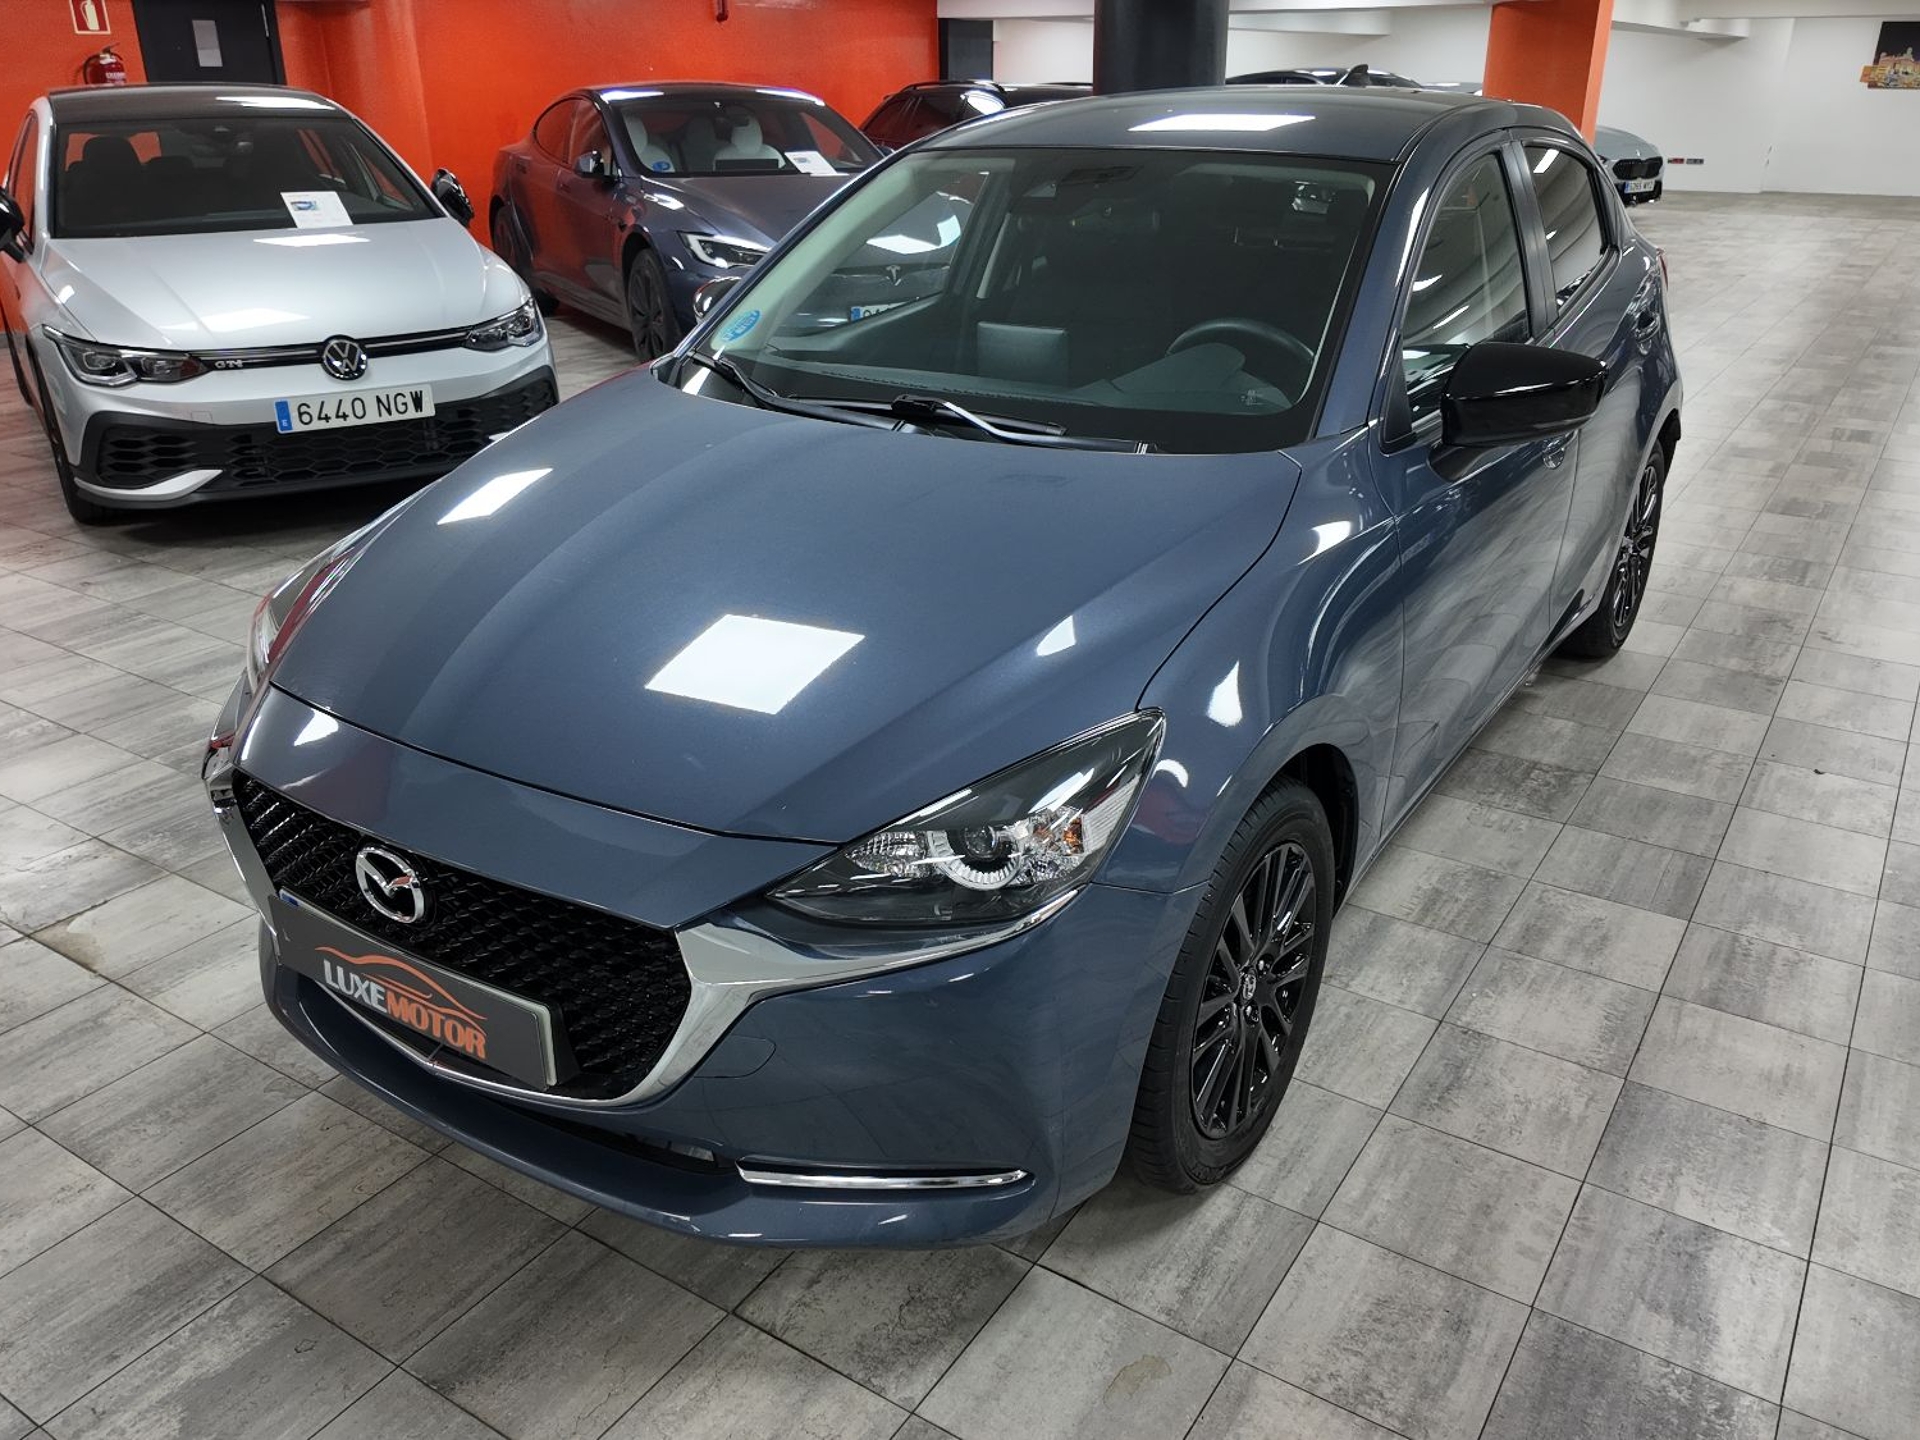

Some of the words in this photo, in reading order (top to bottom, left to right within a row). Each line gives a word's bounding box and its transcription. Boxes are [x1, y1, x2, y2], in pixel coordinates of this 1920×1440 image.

[297, 397, 366, 426] 6440
[376, 389, 423, 417] NGW
[323, 958, 487, 1059] LUXEMOTOR
